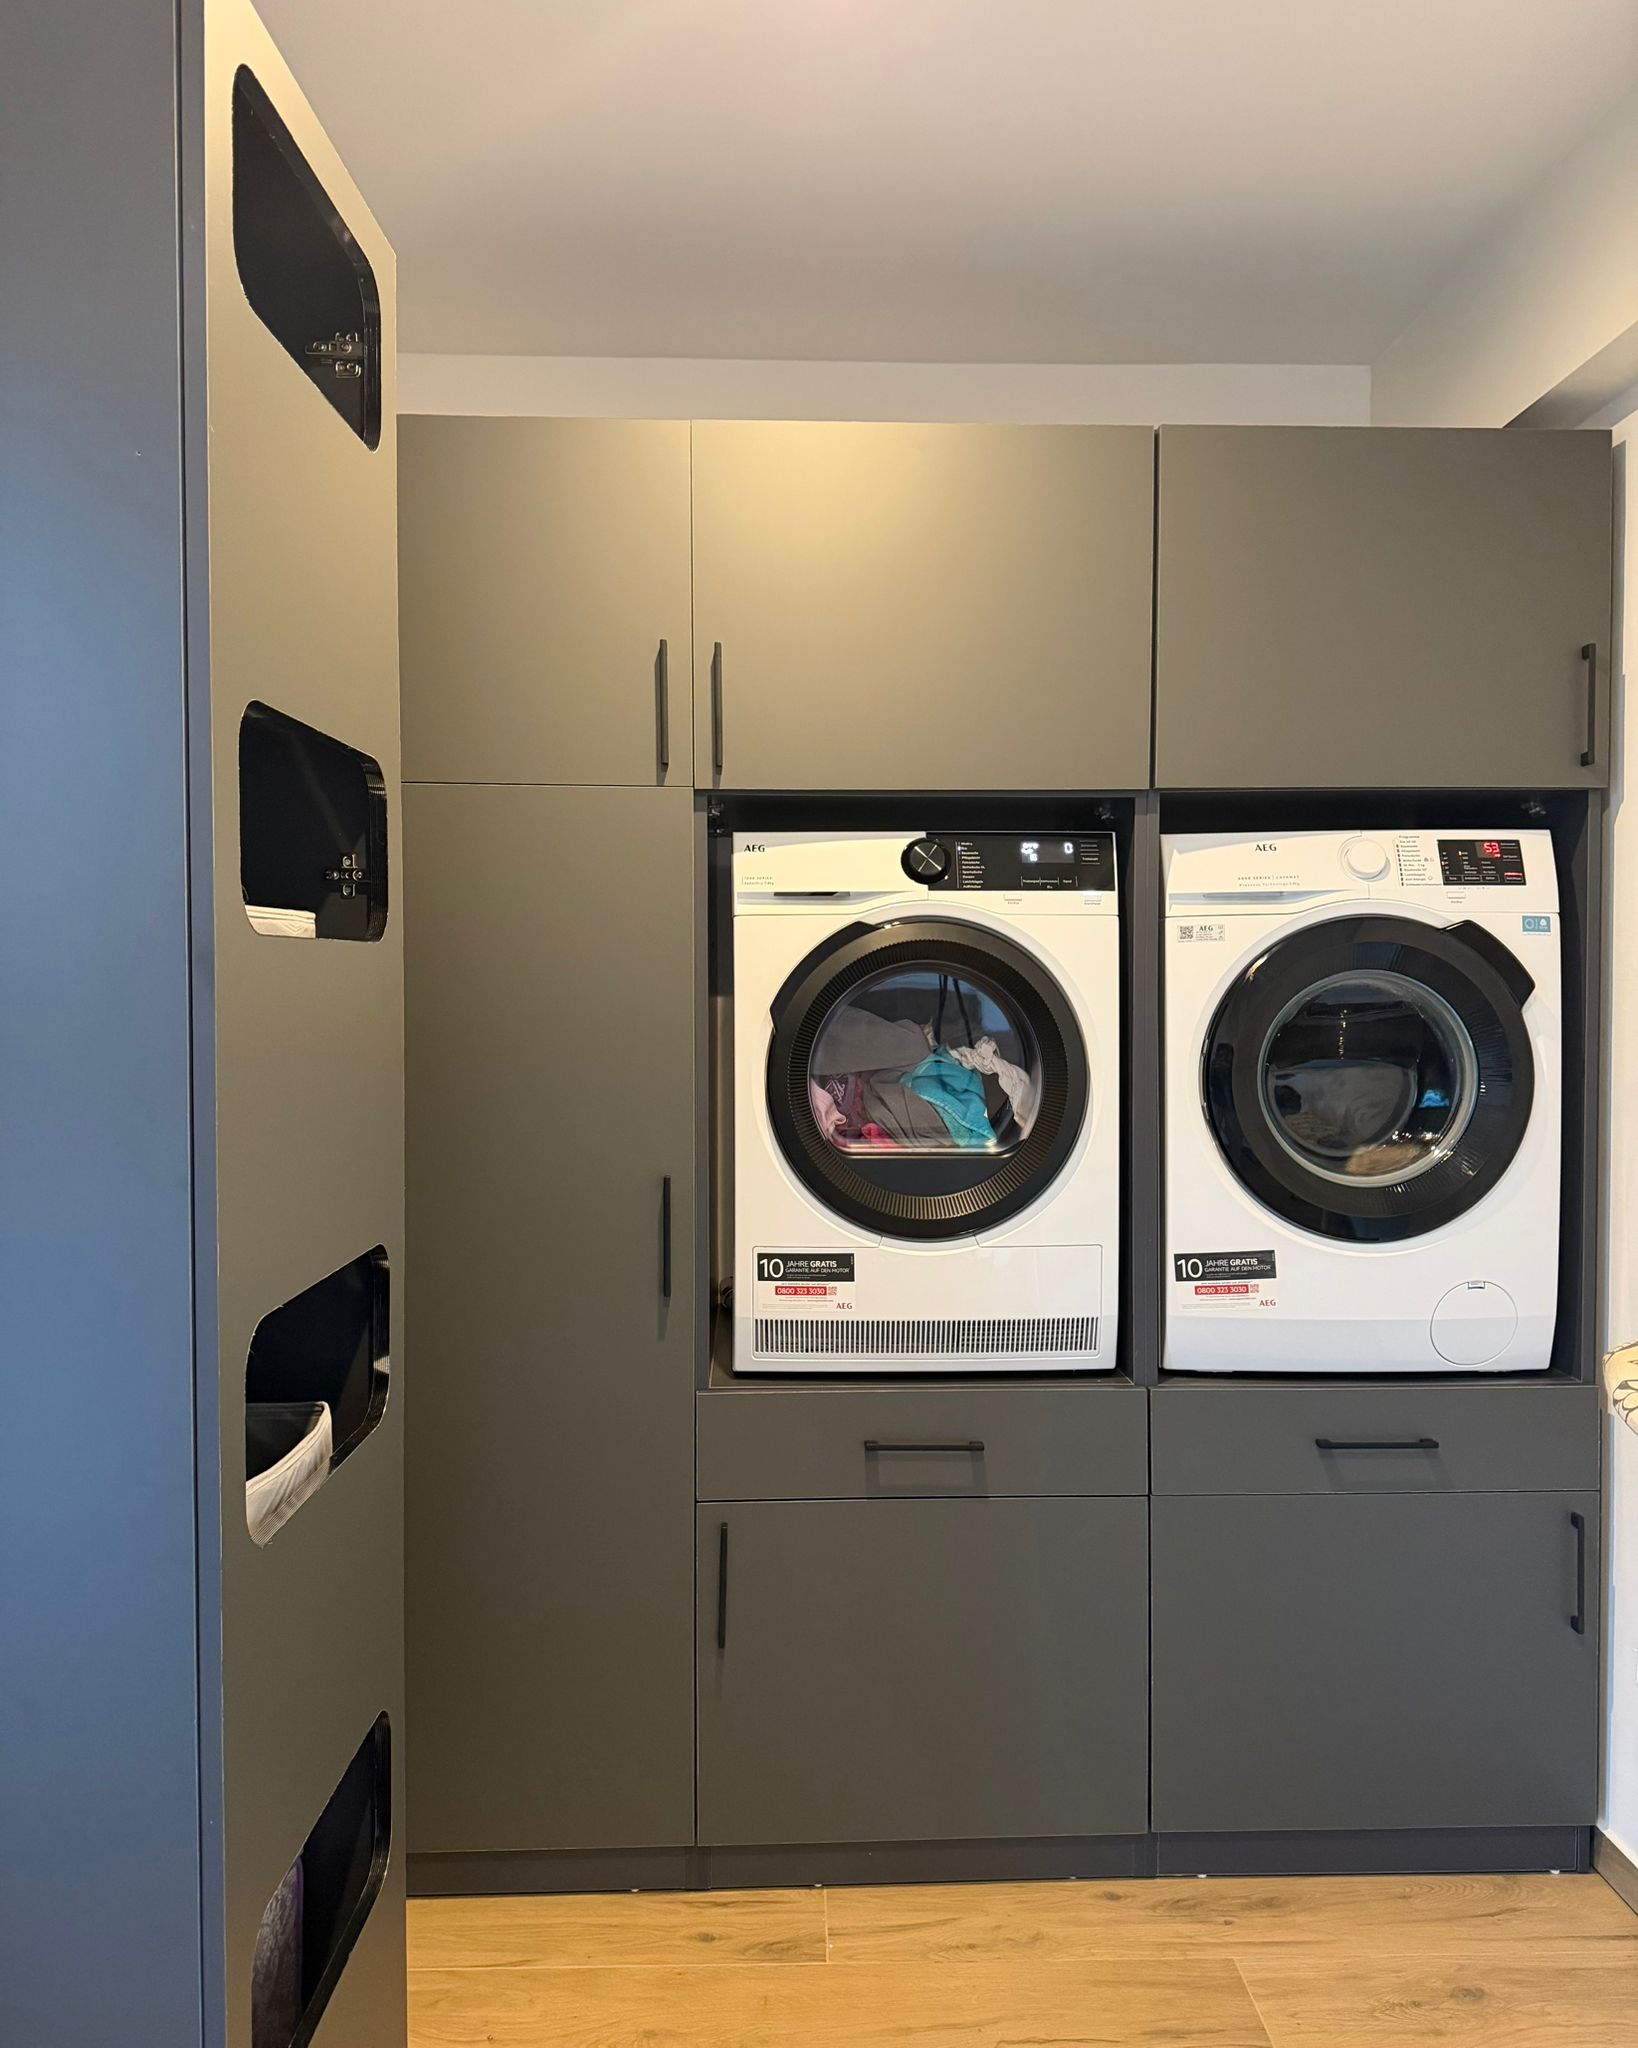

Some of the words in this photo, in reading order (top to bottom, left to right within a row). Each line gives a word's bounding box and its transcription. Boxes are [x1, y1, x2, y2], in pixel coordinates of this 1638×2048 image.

[743, 844, 766, 853] AEG
[1255, 842, 1277, 852] AEG
[786, 1260, 809, 1268] JAHRE
[810, 1260, 837, 1268] GRATIS
[1205, 1259, 1229, 1267] JAHRE
[1229, 1258, 1258, 1266] GRATIS
[759, 1258, 784, 1278] 10
[1177, 1258, 1203, 1278] 10
[777, 1287, 795, 1295] 0800
[796, 1287, 808, 1295] 323
[809, 1287, 825, 1295] 3030
[1196, 1286, 1216, 1294] 0800
[836, 1302, 853, 1310] AEG
[1259, 1299, 1276, 1307] AEG
